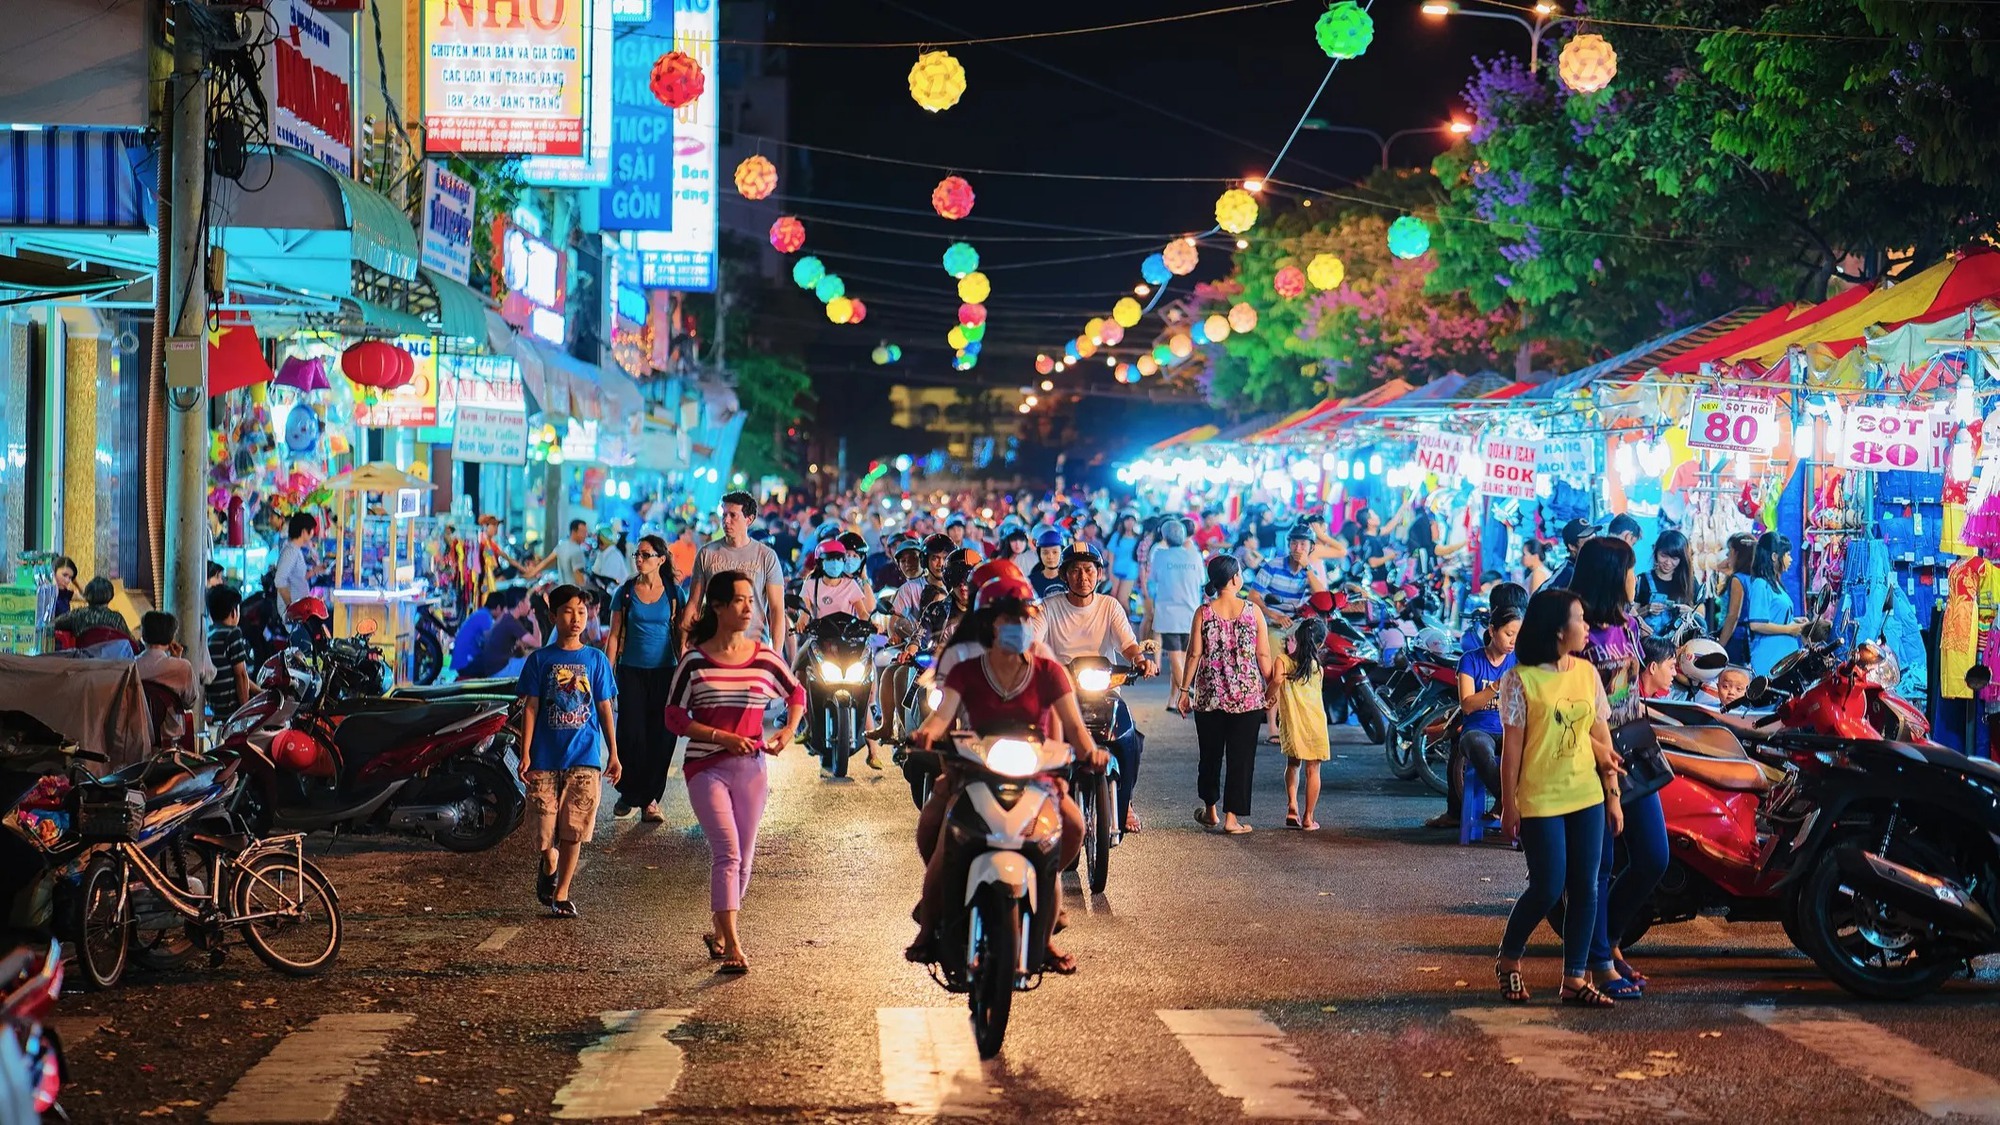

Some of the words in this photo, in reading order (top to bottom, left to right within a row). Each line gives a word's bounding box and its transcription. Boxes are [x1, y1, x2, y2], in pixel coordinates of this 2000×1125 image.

[618, 146, 655, 182] SÀI
[612, 184, 660, 219] GÒN
[1704, 412, 1758, 445] 80
[1850, 441, 1919, 467] 80
[1485, 464, 1534, 484] 160K
